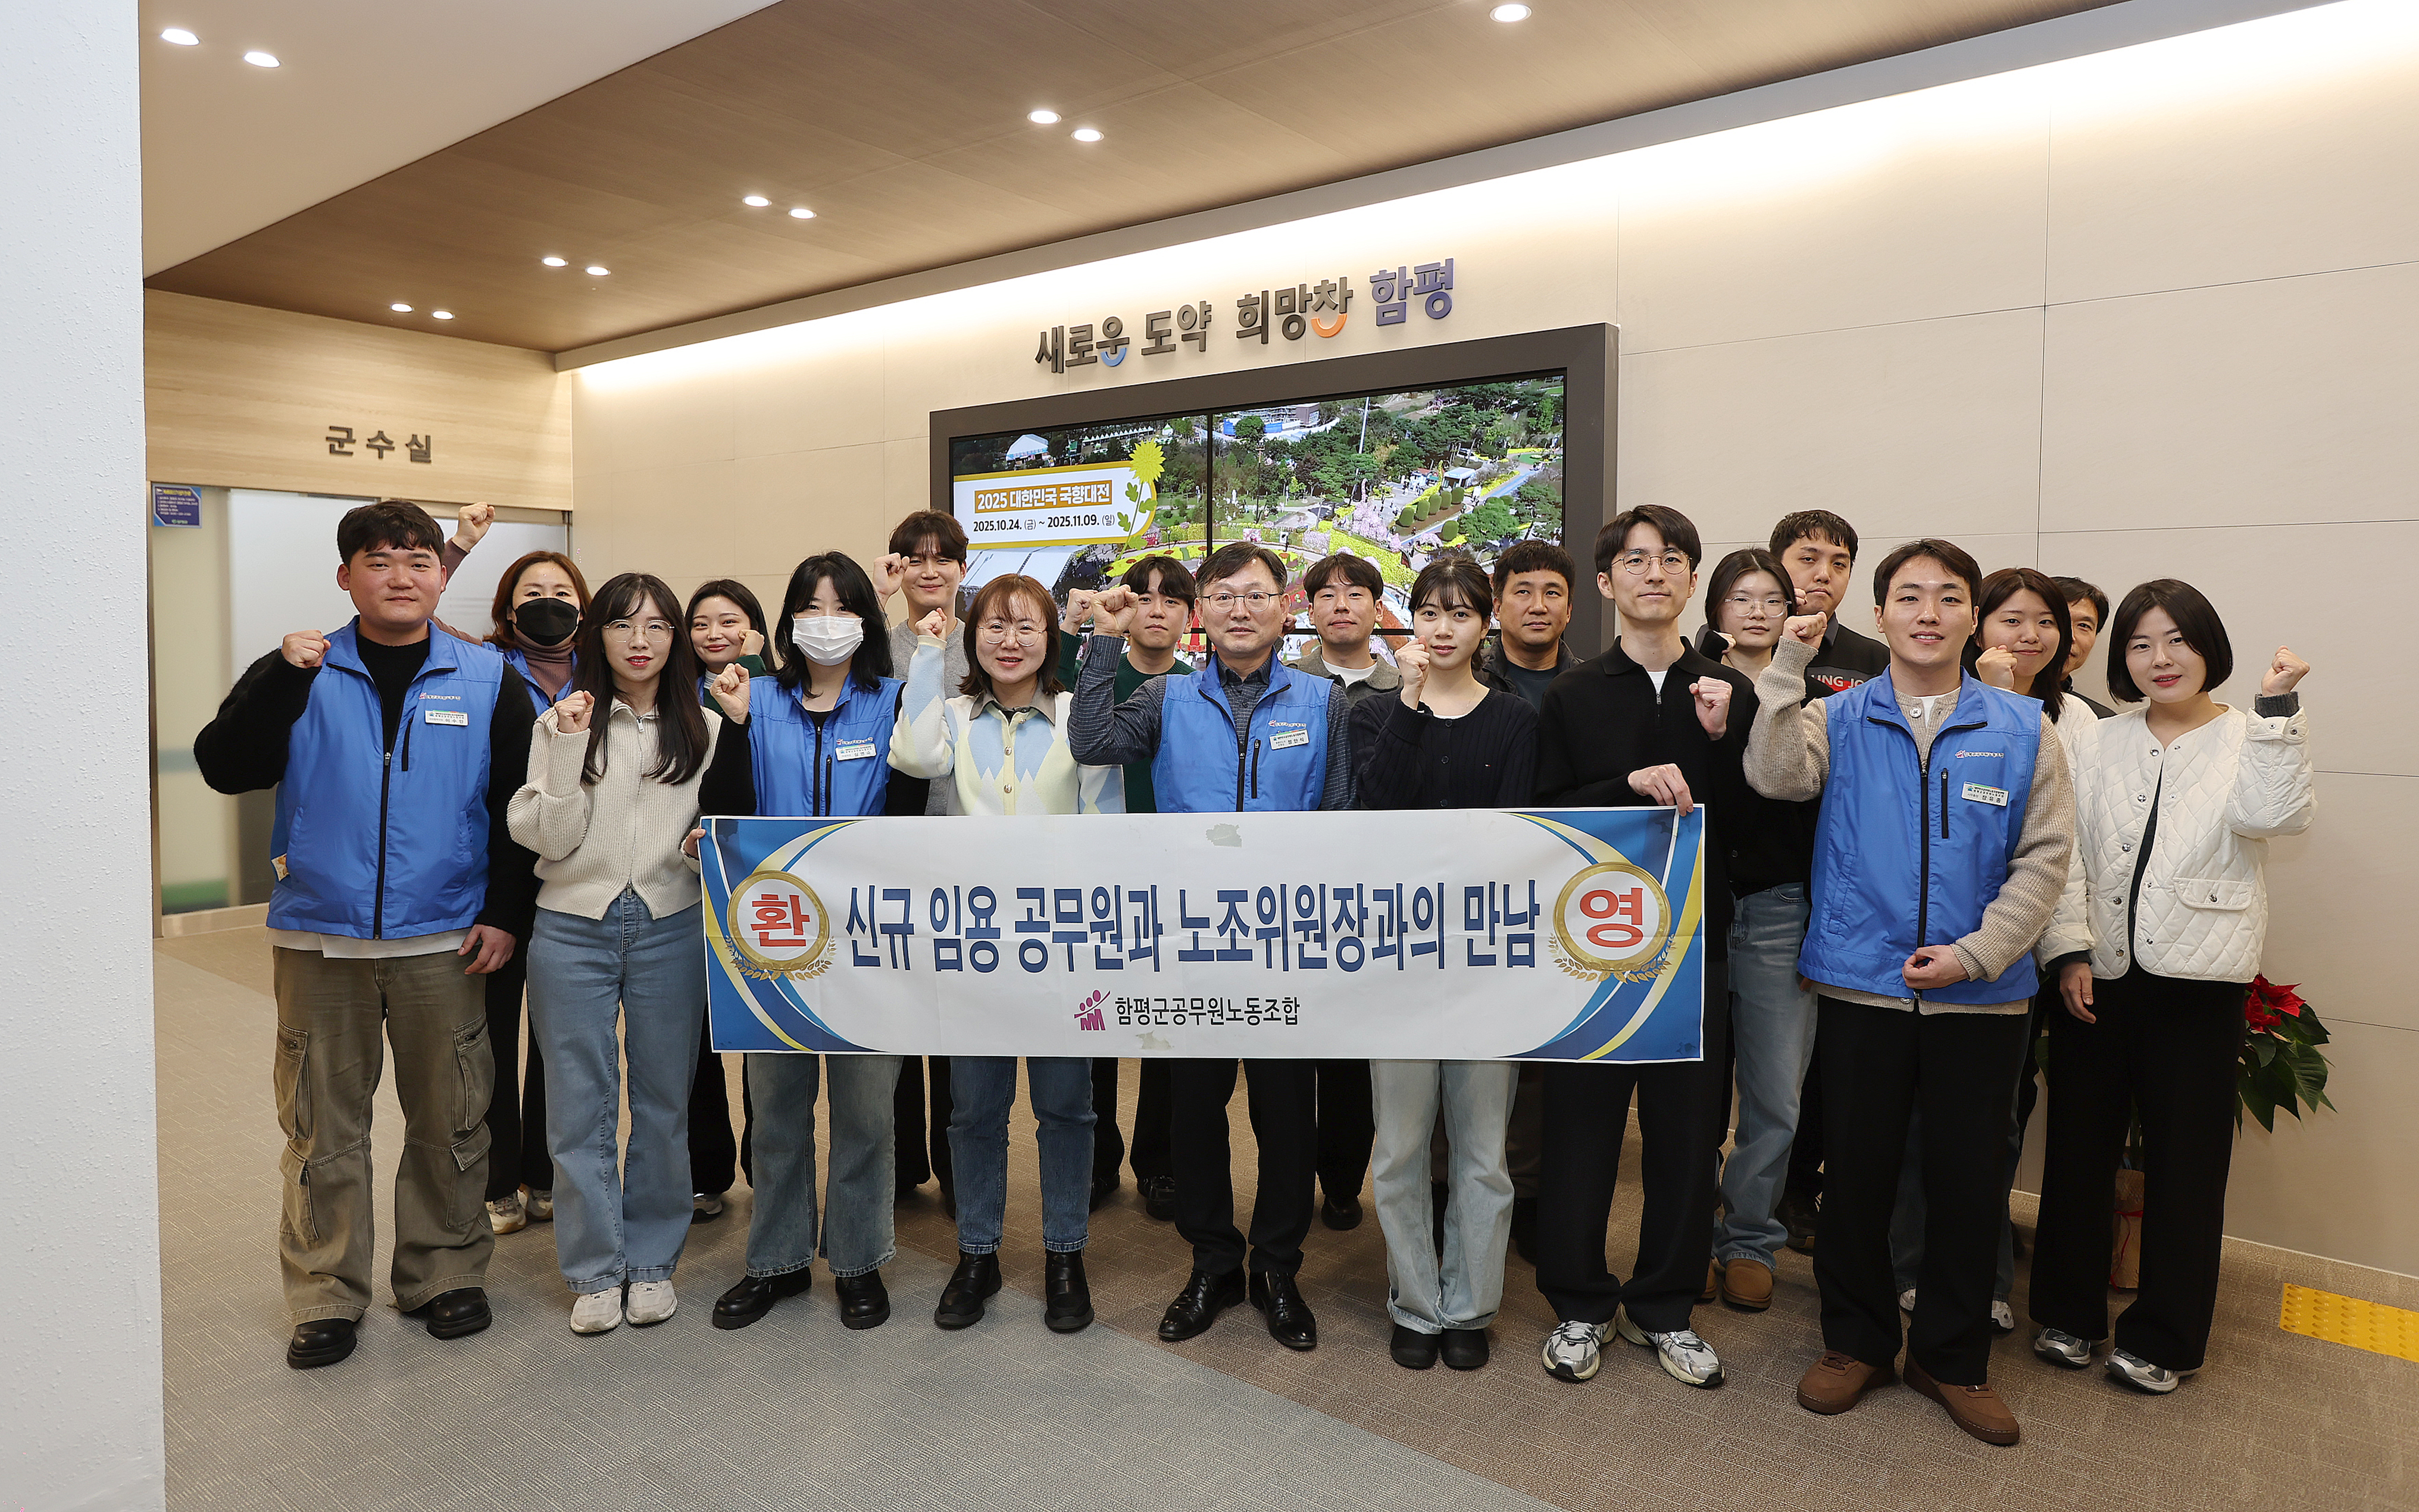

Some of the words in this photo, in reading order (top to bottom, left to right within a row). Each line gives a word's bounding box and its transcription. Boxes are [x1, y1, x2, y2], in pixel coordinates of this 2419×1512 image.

[1035, 315, 1130, 374] 새로운
[1140, 300, 1212, 356] 도약
[1369, 258, 1455, 327] 함평
[326, 425, 432, 463] 군수실
[977, 492, 1008, 510] 2025
[1010, 488, 1057, 508] 대한민국
[1060, 484, 1111, 505] 국향대전
[973, 519, 1022, 532] 2025.10.24.
[1024, 519, 1036, 530] (금)
[1048, 514, 1099, 528] 2025.11.09.
[1102, 515, 1115, 526] (일)
[750, 894, 810, 947] 환
[845, 885, 915, 971] 신규
[929, 885, 1002, 973] 임용
[1014, 884, 1164, 973] 공무원과
[1177, 882, 1445, 972] 노조위원장과의
[1463, 879, 1540, 969] 만남
[1579, 887, 1644, 948] 영
[1115, 997, 1300, 1026] 함평군공무원노동조합
